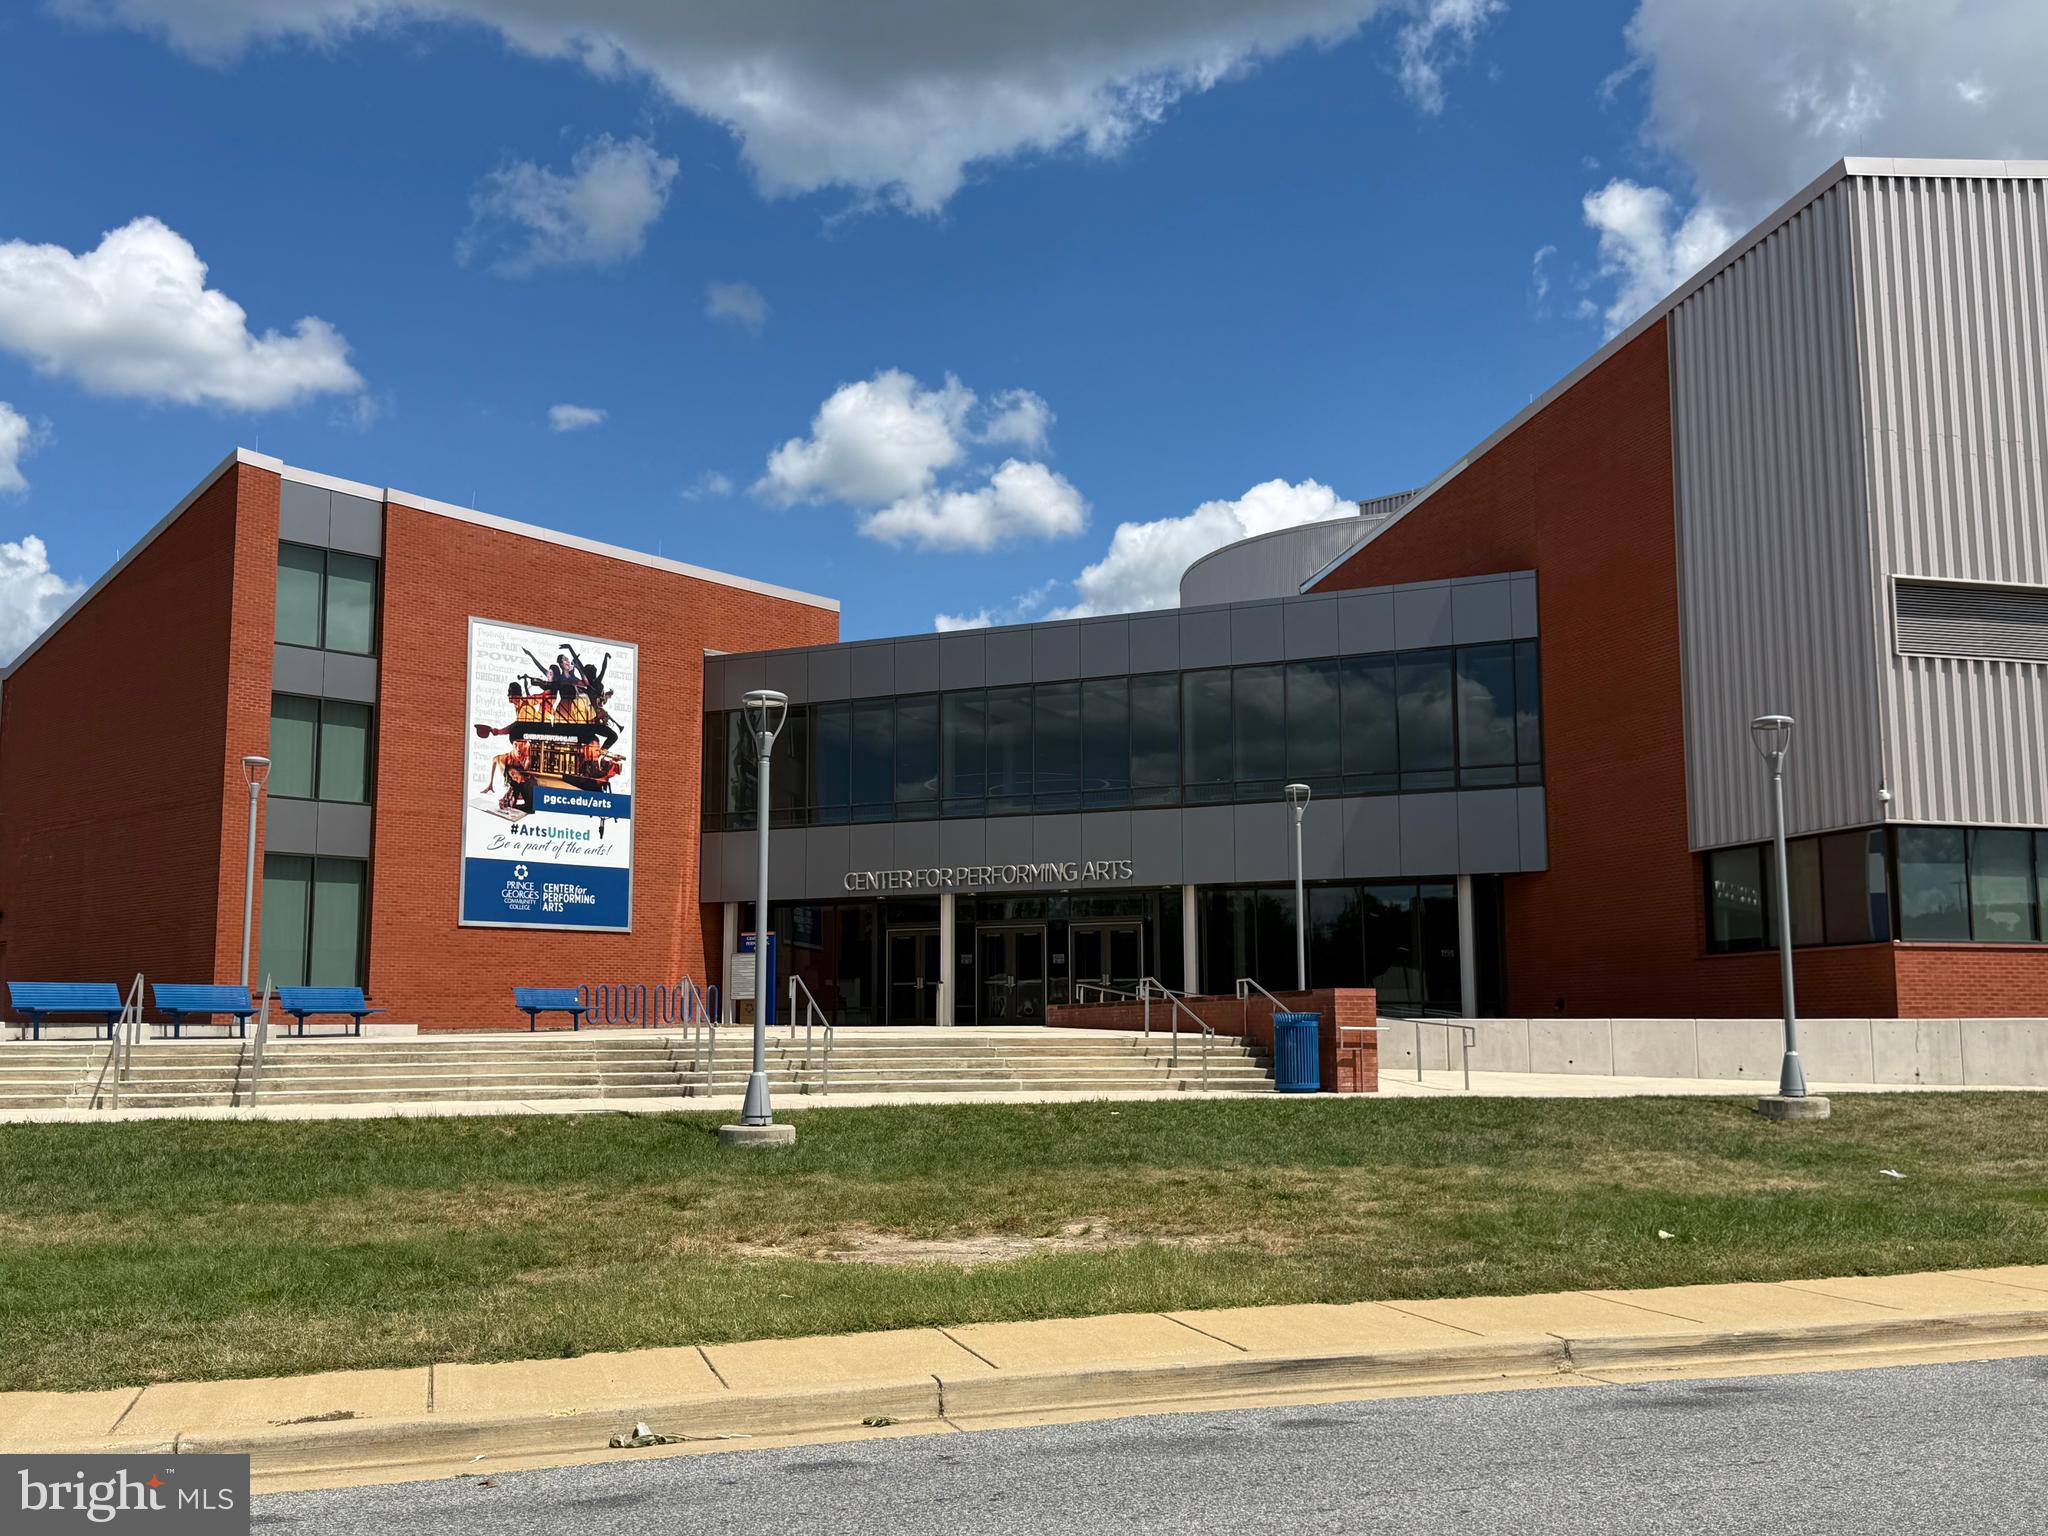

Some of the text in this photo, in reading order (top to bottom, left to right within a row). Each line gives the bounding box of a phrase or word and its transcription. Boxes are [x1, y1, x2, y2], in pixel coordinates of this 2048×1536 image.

[544, 794, 612, 808] pgcc.edu/arts
[510, 823, 591, 841] #ArtsUnited
[487, 834, 613, 859] Be a part of the arts!
[843, 860, 1133, 891] CENTER FOR PERFORMING ARTS
[506, 880, 535, 891] PRINCE
[543, 883, 588, 896] CENTER for
[542, 892, 596, 905] PERFORMING
[542, 902, 564, 912] ARTS
